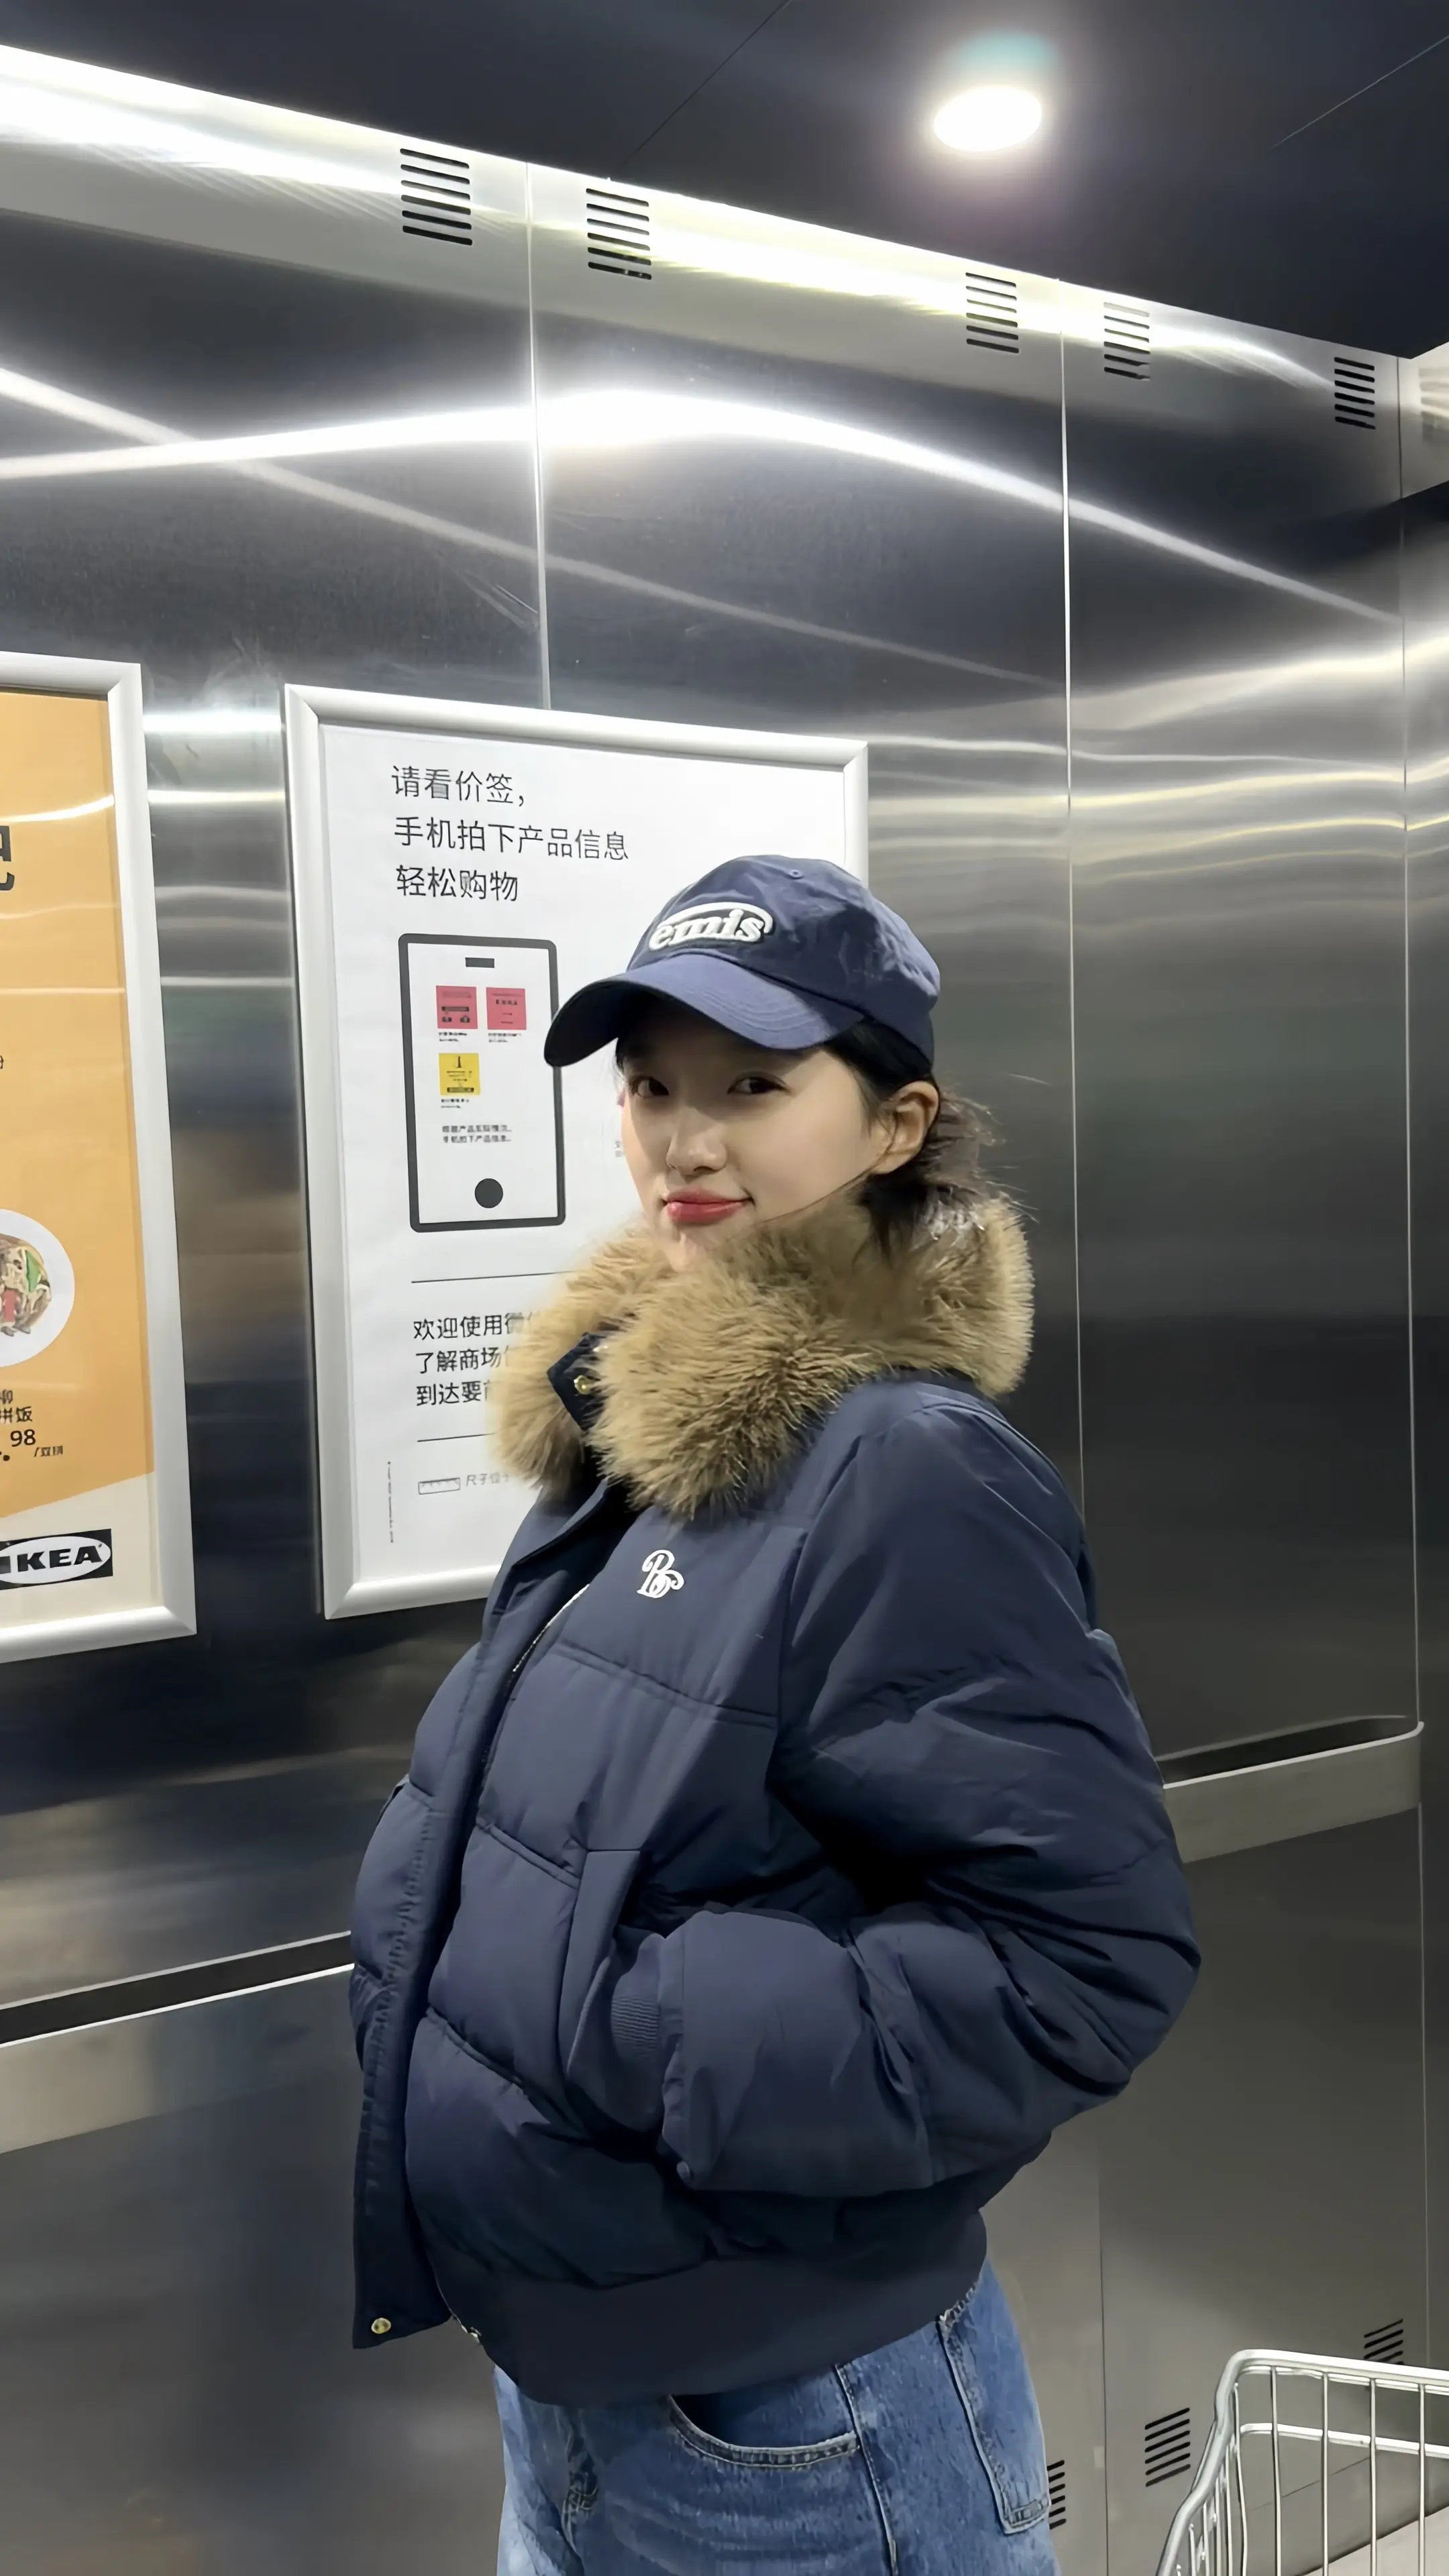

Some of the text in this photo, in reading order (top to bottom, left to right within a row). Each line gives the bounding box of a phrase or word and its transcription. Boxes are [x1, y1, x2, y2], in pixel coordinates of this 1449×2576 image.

[392, 765, 525, 807] 请看价签，
[394, 816, 628, 861] 手机拍下产品信息
[396, 865, 519, 902] 轻松购物
[649, 908, 762, 951] emis
[415, 1345, 510, 1375] 了解商场
[0, 1545, 102, 1574] IKEA
